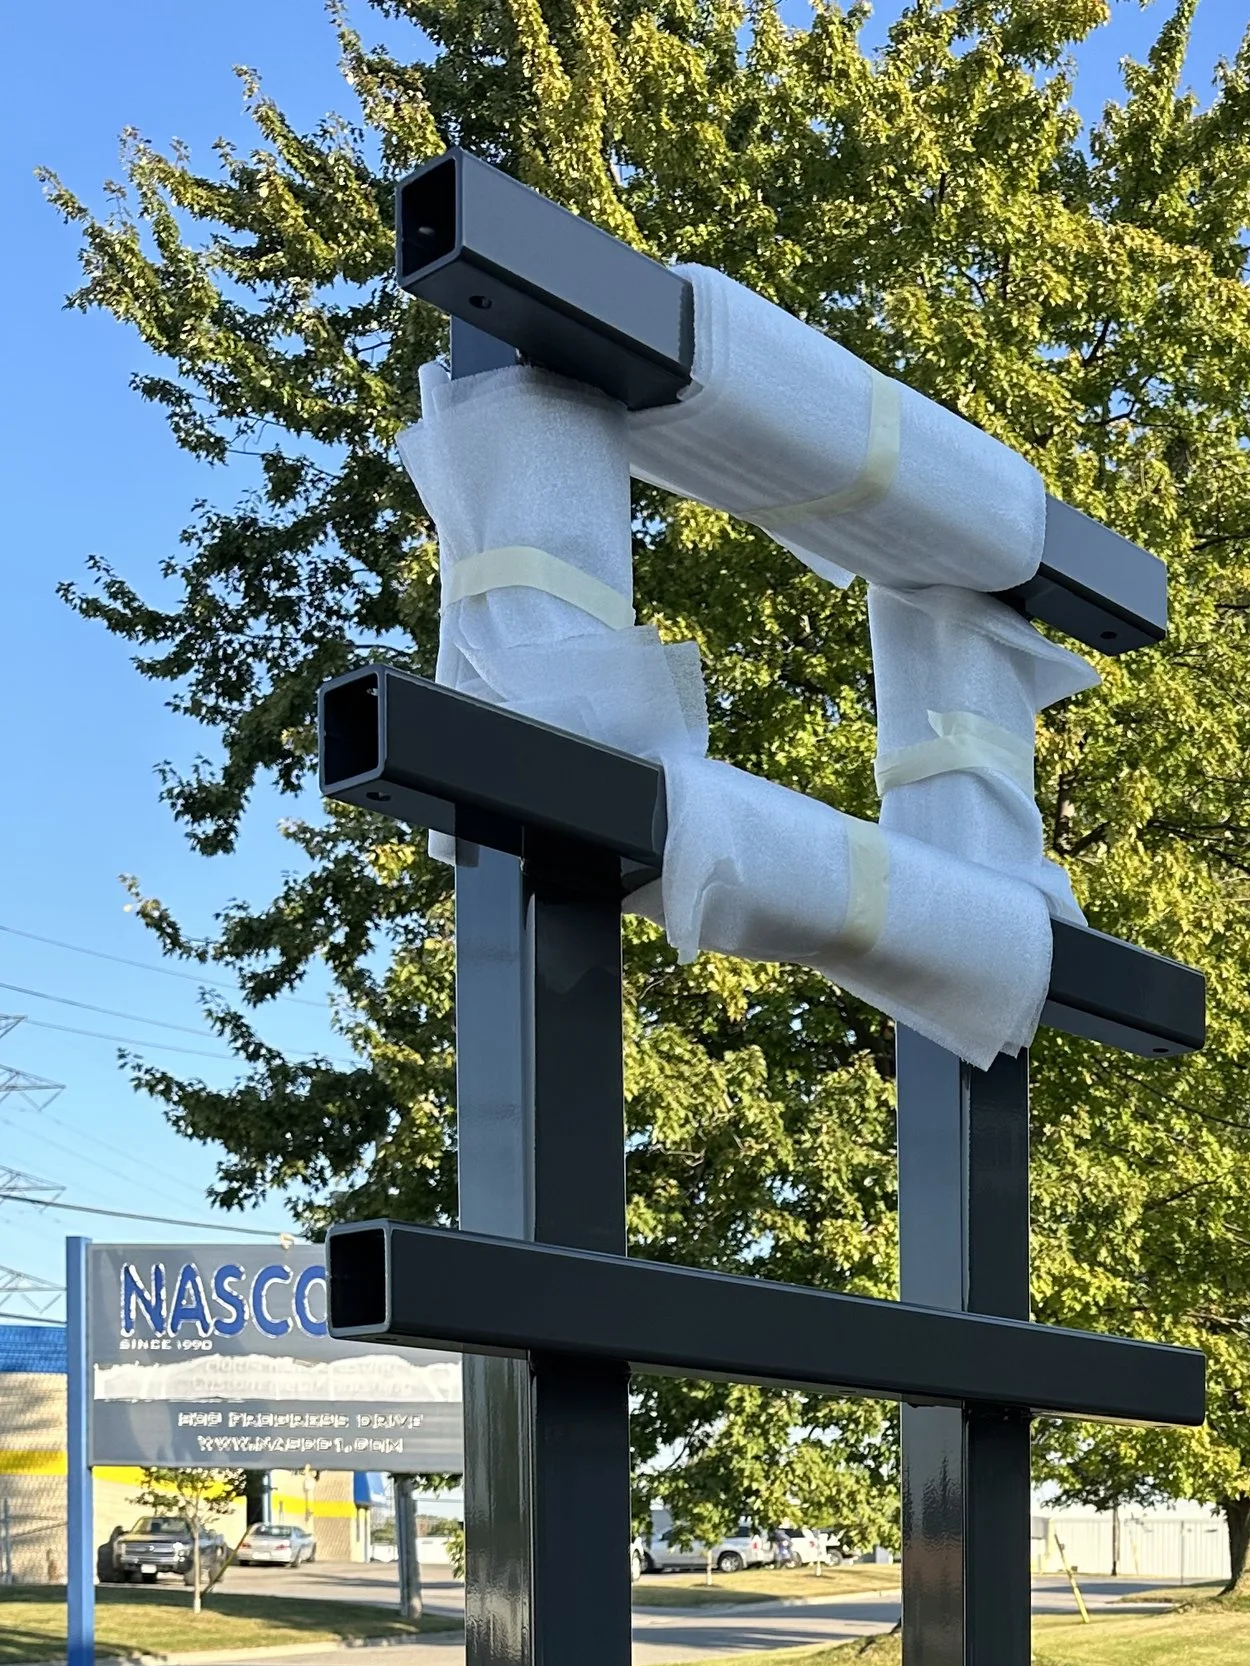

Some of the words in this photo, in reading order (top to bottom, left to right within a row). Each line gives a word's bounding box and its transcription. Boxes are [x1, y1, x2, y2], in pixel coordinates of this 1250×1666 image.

[119, 1338, 172, 1350] SINCE
[177, 1339, 213, 1350] 1990
[355, 1413, 424, 1430] DRIVE
